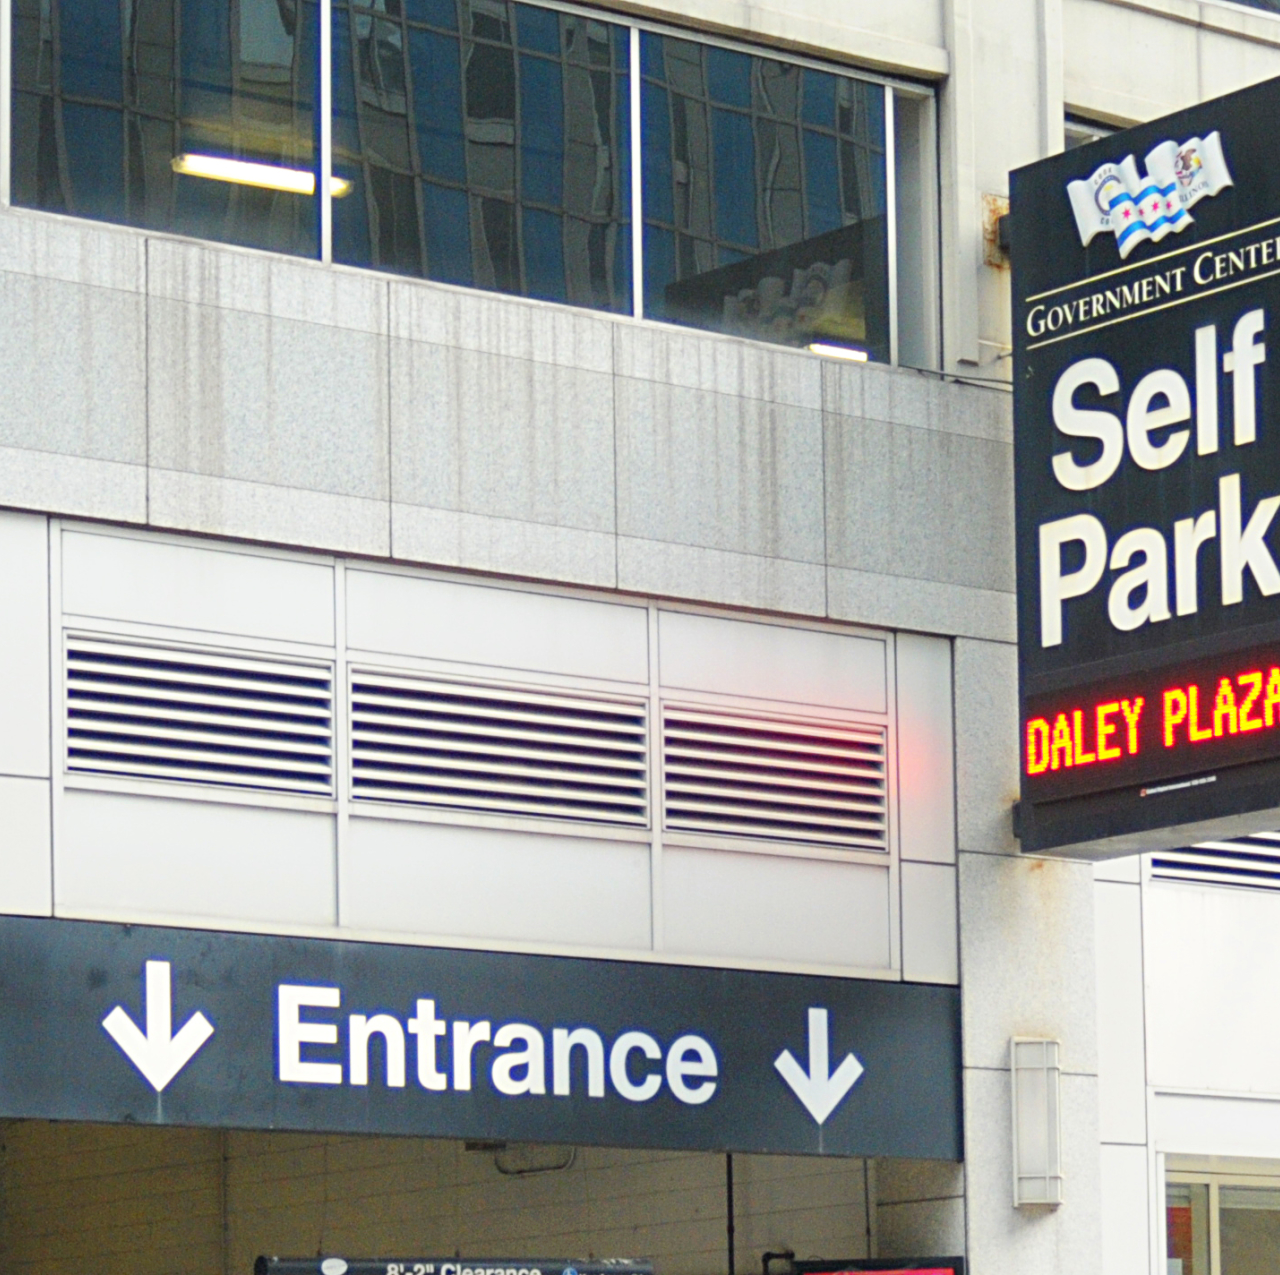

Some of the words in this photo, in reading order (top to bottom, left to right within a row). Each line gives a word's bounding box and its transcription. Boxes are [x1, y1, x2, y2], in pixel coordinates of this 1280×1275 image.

[1025, 266, 1186, 338] GOVERNMENT
[1050, 307, 1267, 492] Self
[1025, 696, 1145, 776] DALEY
[276, 982, 719, 1106] Entrance
